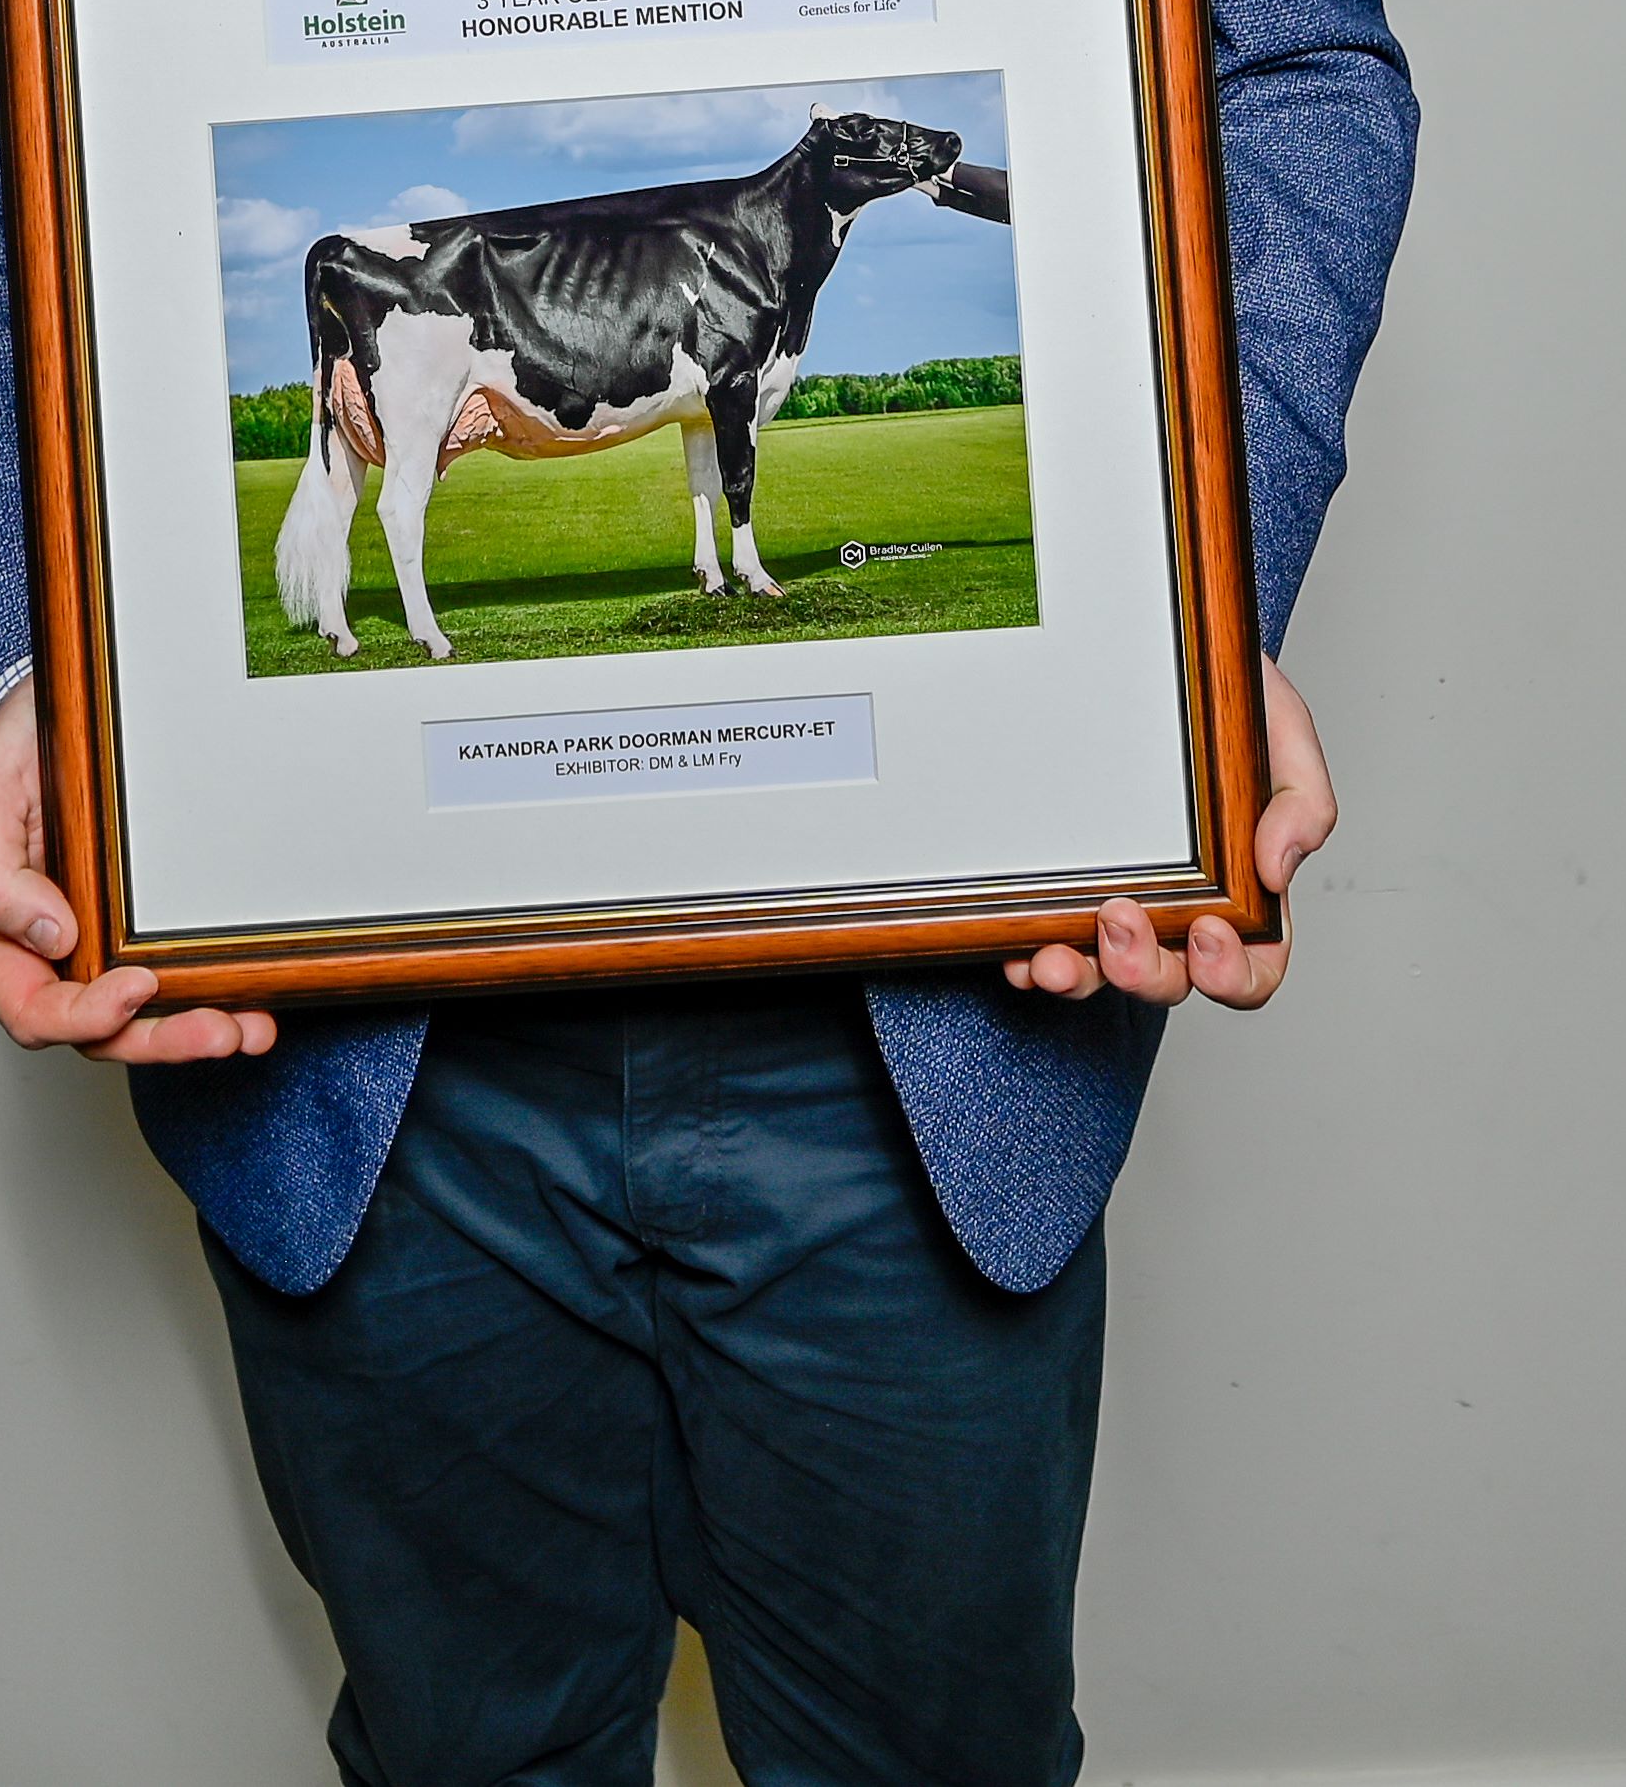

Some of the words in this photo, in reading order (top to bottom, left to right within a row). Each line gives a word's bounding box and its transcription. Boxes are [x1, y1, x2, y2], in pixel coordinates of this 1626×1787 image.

[462, 8, 629, 38] HONOURABLE
[636, 0, 743, 26] MENTION
[798, 2, 851, 17] Genetics
[853, 0, 871, 13] for
[303, 8, 406, 36] Holstein
[321, 36, 390, 49] AUSTRALIA
[869, 545, 909, 556] Bradley
[458, 739, 559, 761] KATANDRA
[564, 735, 614, 754] PARK
[618, 729, 713, 750] DOORMAN
[717, 721, 836, 744] MERCURY-ET
[555, 758, 645, 776] EXHIBITOR:
[649, 755, 673, 771] DM
[677, 755, 688, 768] &
[692, 753, 715, 768] LM
[719, 751, 742, 769] Fry
